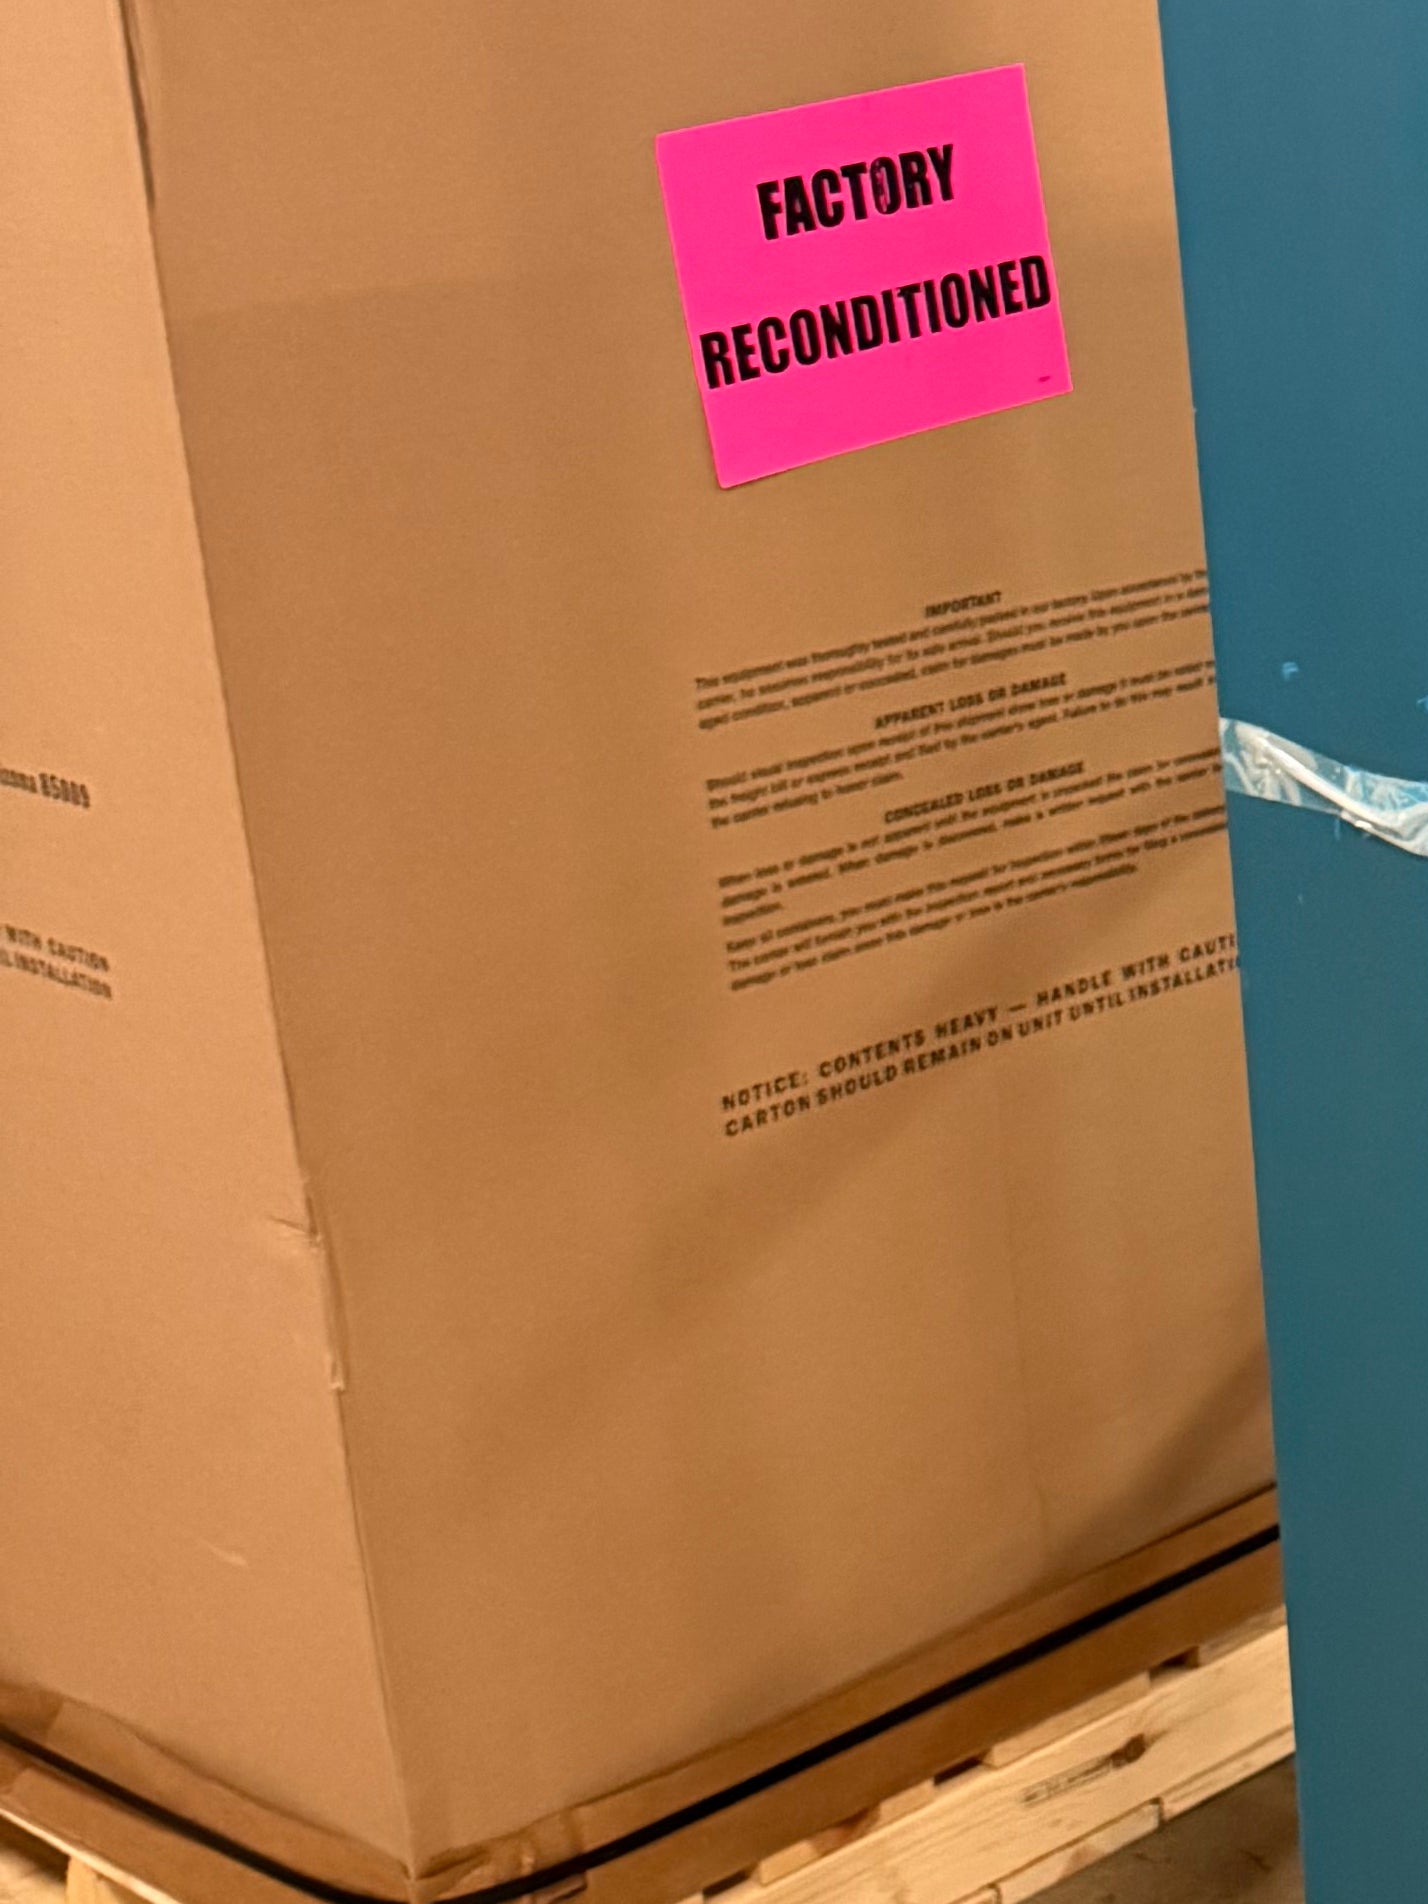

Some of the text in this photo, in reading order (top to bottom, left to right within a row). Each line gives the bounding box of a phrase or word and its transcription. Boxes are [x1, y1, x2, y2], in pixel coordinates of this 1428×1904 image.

[755, 142, 956, 242] FACTORY
[699, 254, 1052, 391] RECONDITIONED
[924, 589, 1002, 619] IMPORTANT
[874, 700, 945, 731] APPARENT
[1010, 671, 1067, 697] DAMAGE
[884, 791, 965, 824] CONCEALED
[1028, 759, 1085, 787] DAMAGE
[721, 1069, 808, 1113] NOTICE:
[817, 1028, 927, 1080] CONTENTS
[934, 1004, 999, 1040] HEAVY
[1035, 969, 1113, 1008] HANDLE
[1120, 953, 1171, 982] WITH
[723, 956, 1240, 1138] CARTON SHOULD REMAIN ON UNIT UNTIL INSTALLATI
